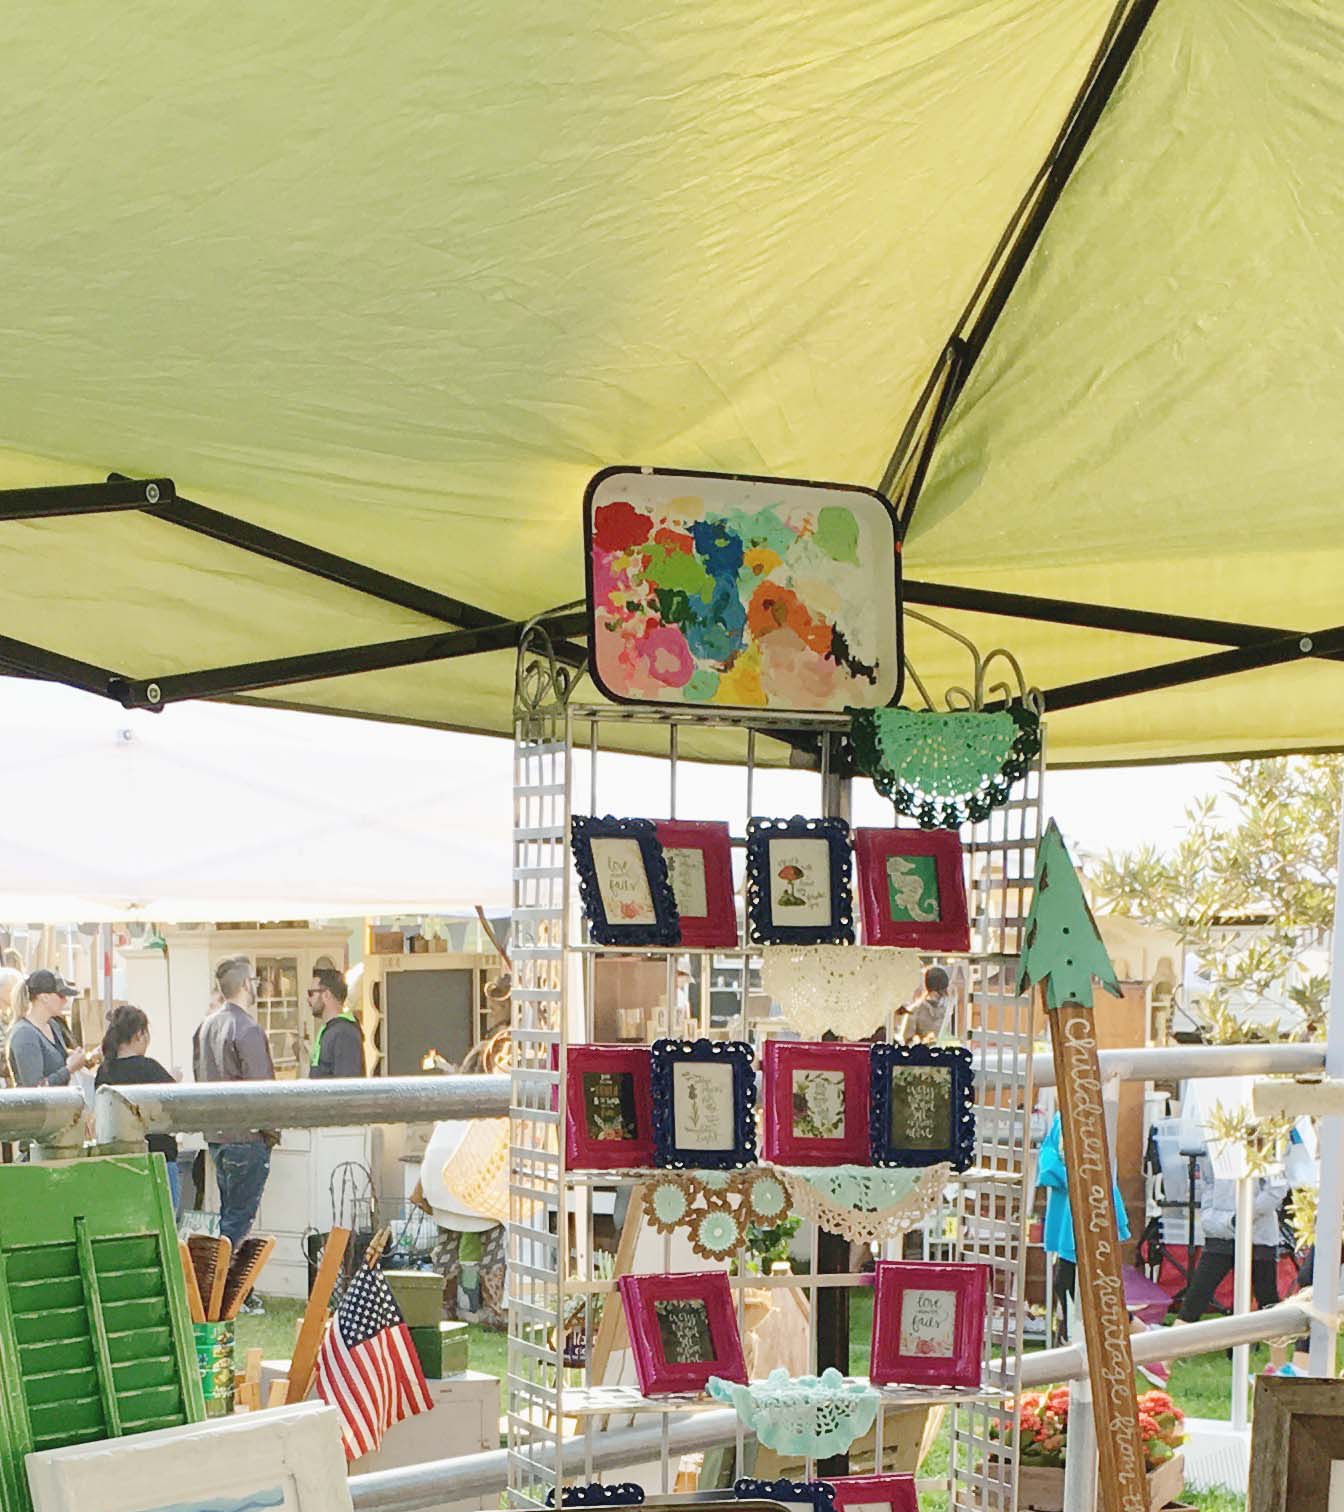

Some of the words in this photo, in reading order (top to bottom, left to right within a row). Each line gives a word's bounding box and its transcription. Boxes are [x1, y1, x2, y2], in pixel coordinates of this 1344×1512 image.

[1088, 1184, 1110, 1233] are
[1095, 1239, 1112, 1262] a
[917, 1293, 942, 1310] love
[1093, 1269, 1132, 1404] heritage
[1109, 1410, 1138, 1484] from
